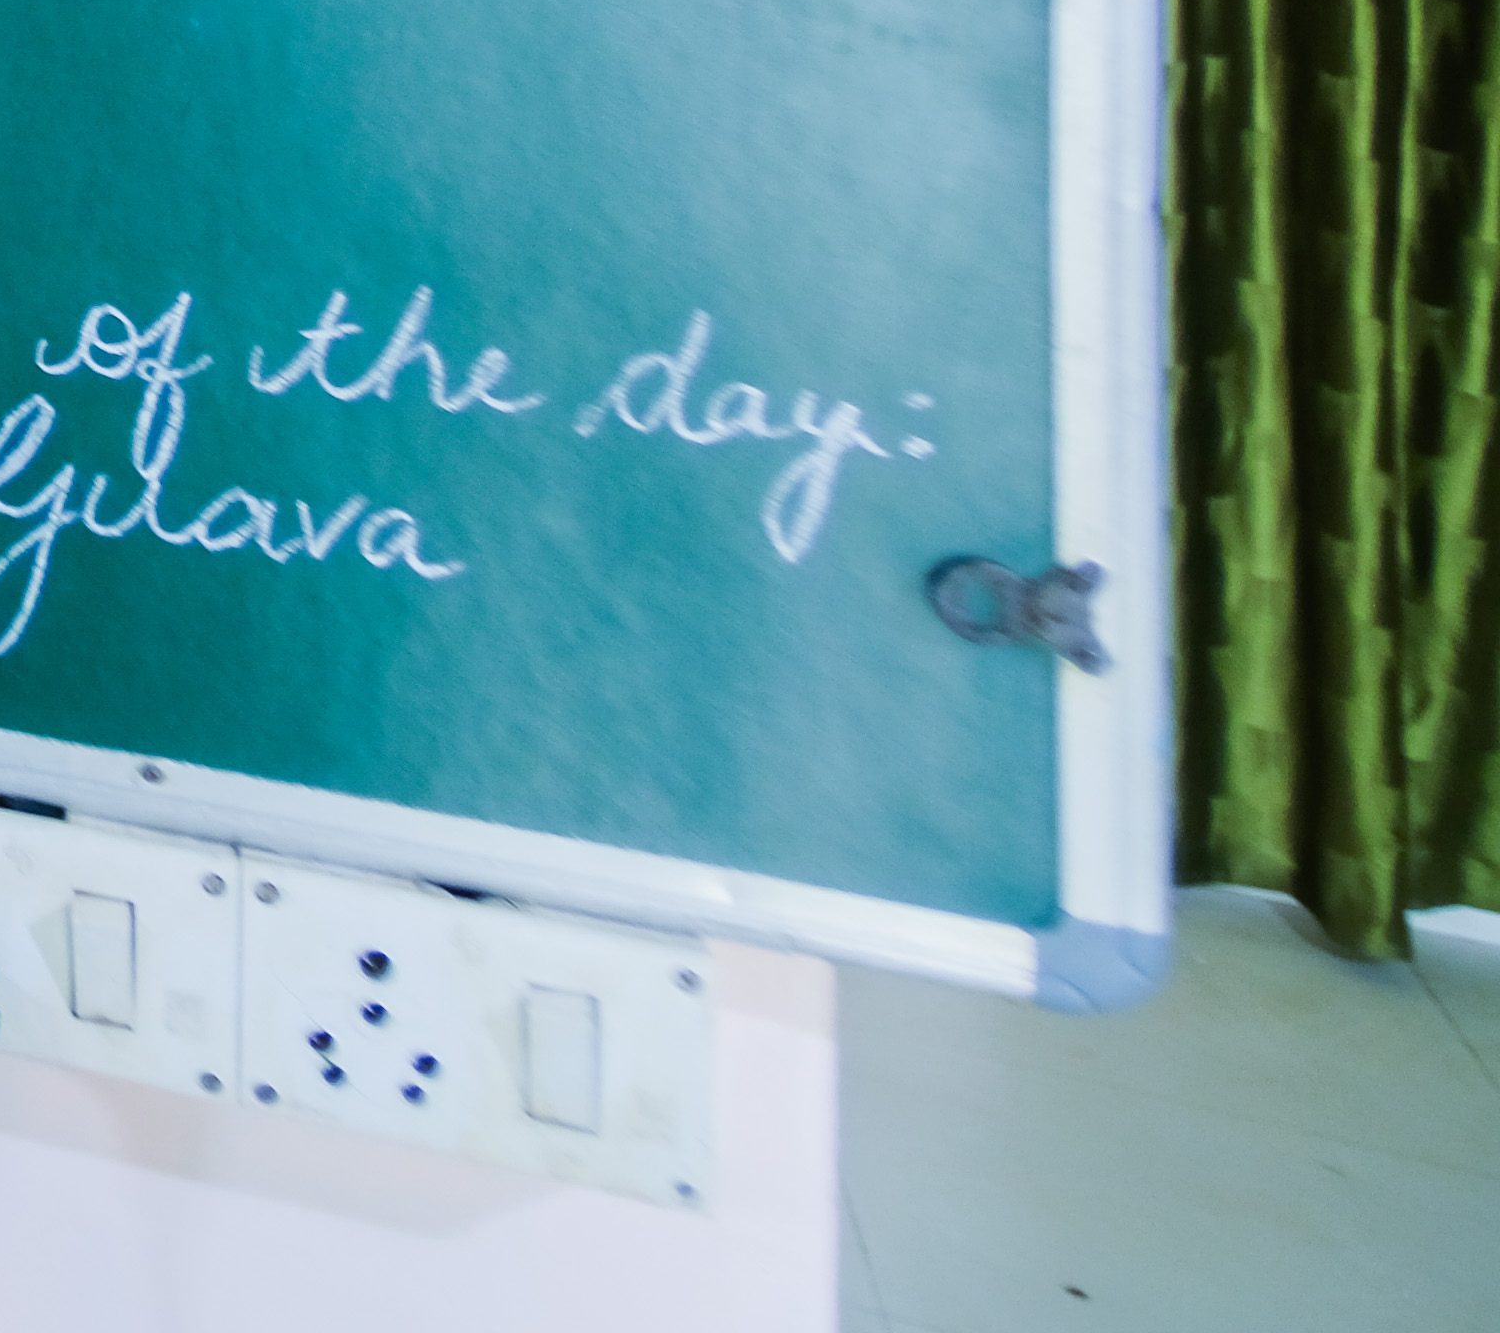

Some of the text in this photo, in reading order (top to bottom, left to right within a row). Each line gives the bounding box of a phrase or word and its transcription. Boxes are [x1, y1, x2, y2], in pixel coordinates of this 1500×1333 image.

[34, 289, 216, 481] of
[247, 283, 548, 415] the
[572, 307, 938, 565] day:
